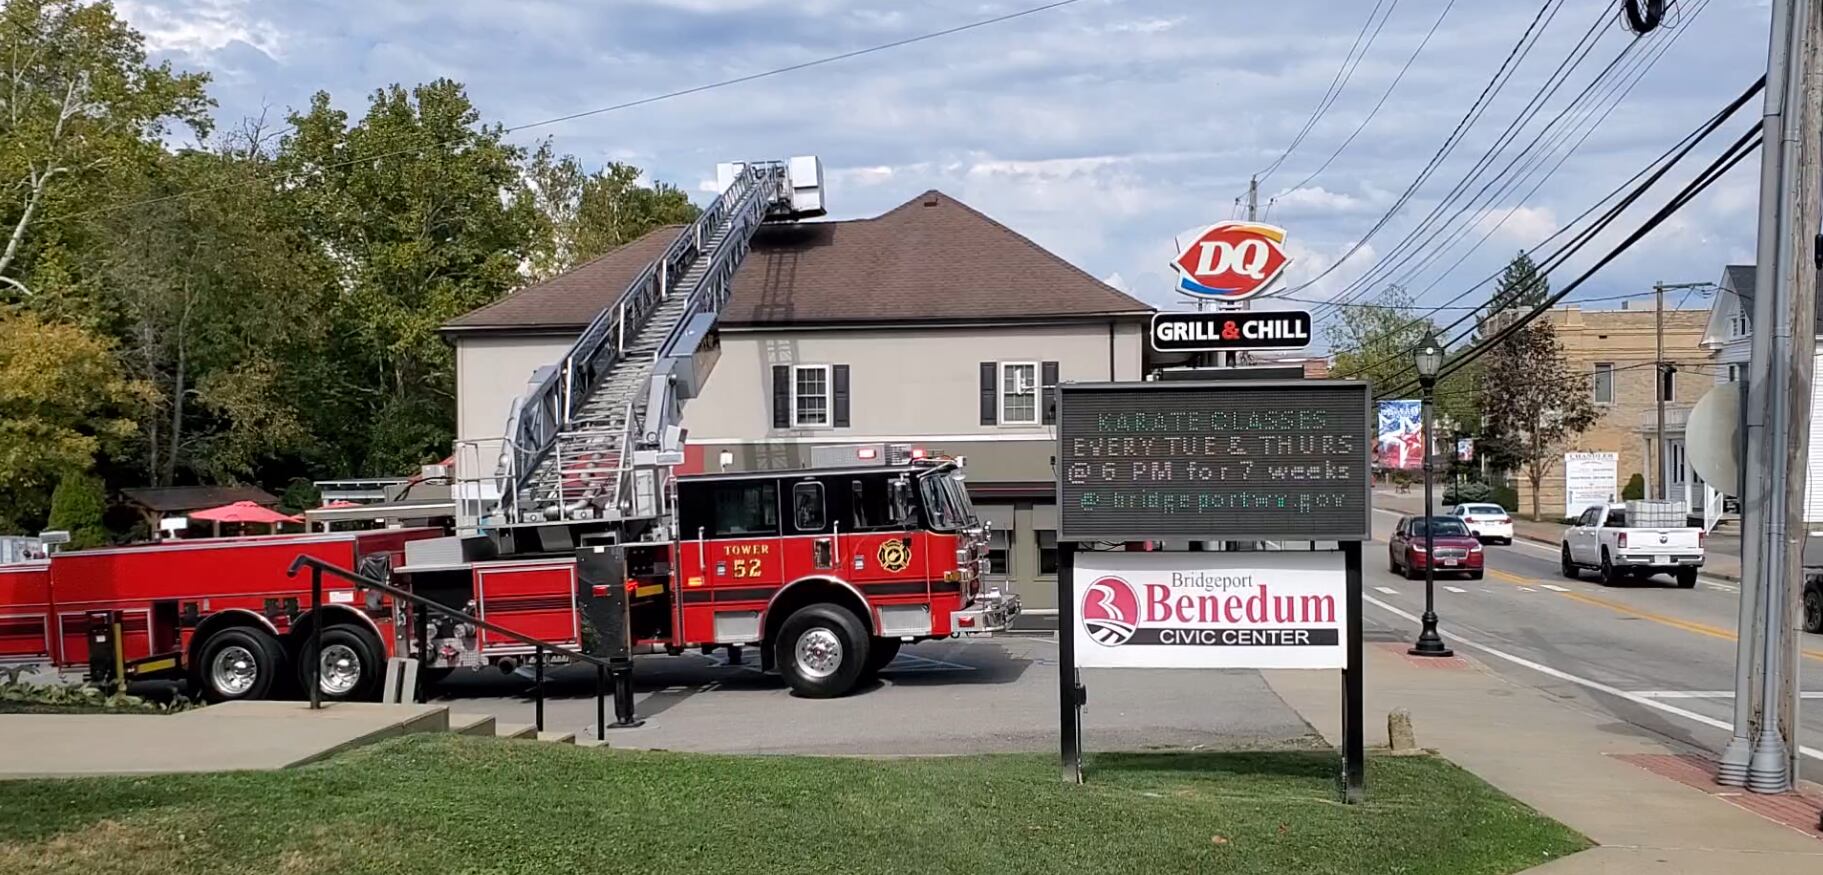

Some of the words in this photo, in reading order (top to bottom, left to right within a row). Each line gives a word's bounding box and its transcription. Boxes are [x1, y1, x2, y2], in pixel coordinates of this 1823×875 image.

[1195, 239, 1269, 280] DQ
[1156, 321, 1220, 341] GRILL
[1222, 320, 1240, 340] &
[1242, 319, 1308, 339] CHILL
[1098, 411, 1199, 432] KARATE
[1211, 409, 1326, 431] CLASSES
[1074, 436, 1156, 457] EVERY
[1164, 436, 1216, 456] TUE
[1227, 436, 1247, 456] &
[1258, 434, 1353, 455] THURS
[1068, 462, 1091, 484] @
[1102, 462, 1116, 481] 6
[1132, 461, 1172, 481] PM
[1186, 461, 1228, 481] for
[1239, 460, 1254, 480] 7
[1268, 459, 1350, 480] weeks
[723, 544, 769, 556] TOWER
[733, 559, 762, 578] 52
[1171, 572, 1253, 592] Bridgeport
[1142, 583, 1336, 624] Benedum
[1159, 630, 1215, 645] CIVIC
[1222, 630, 1310, 645] CENTER
